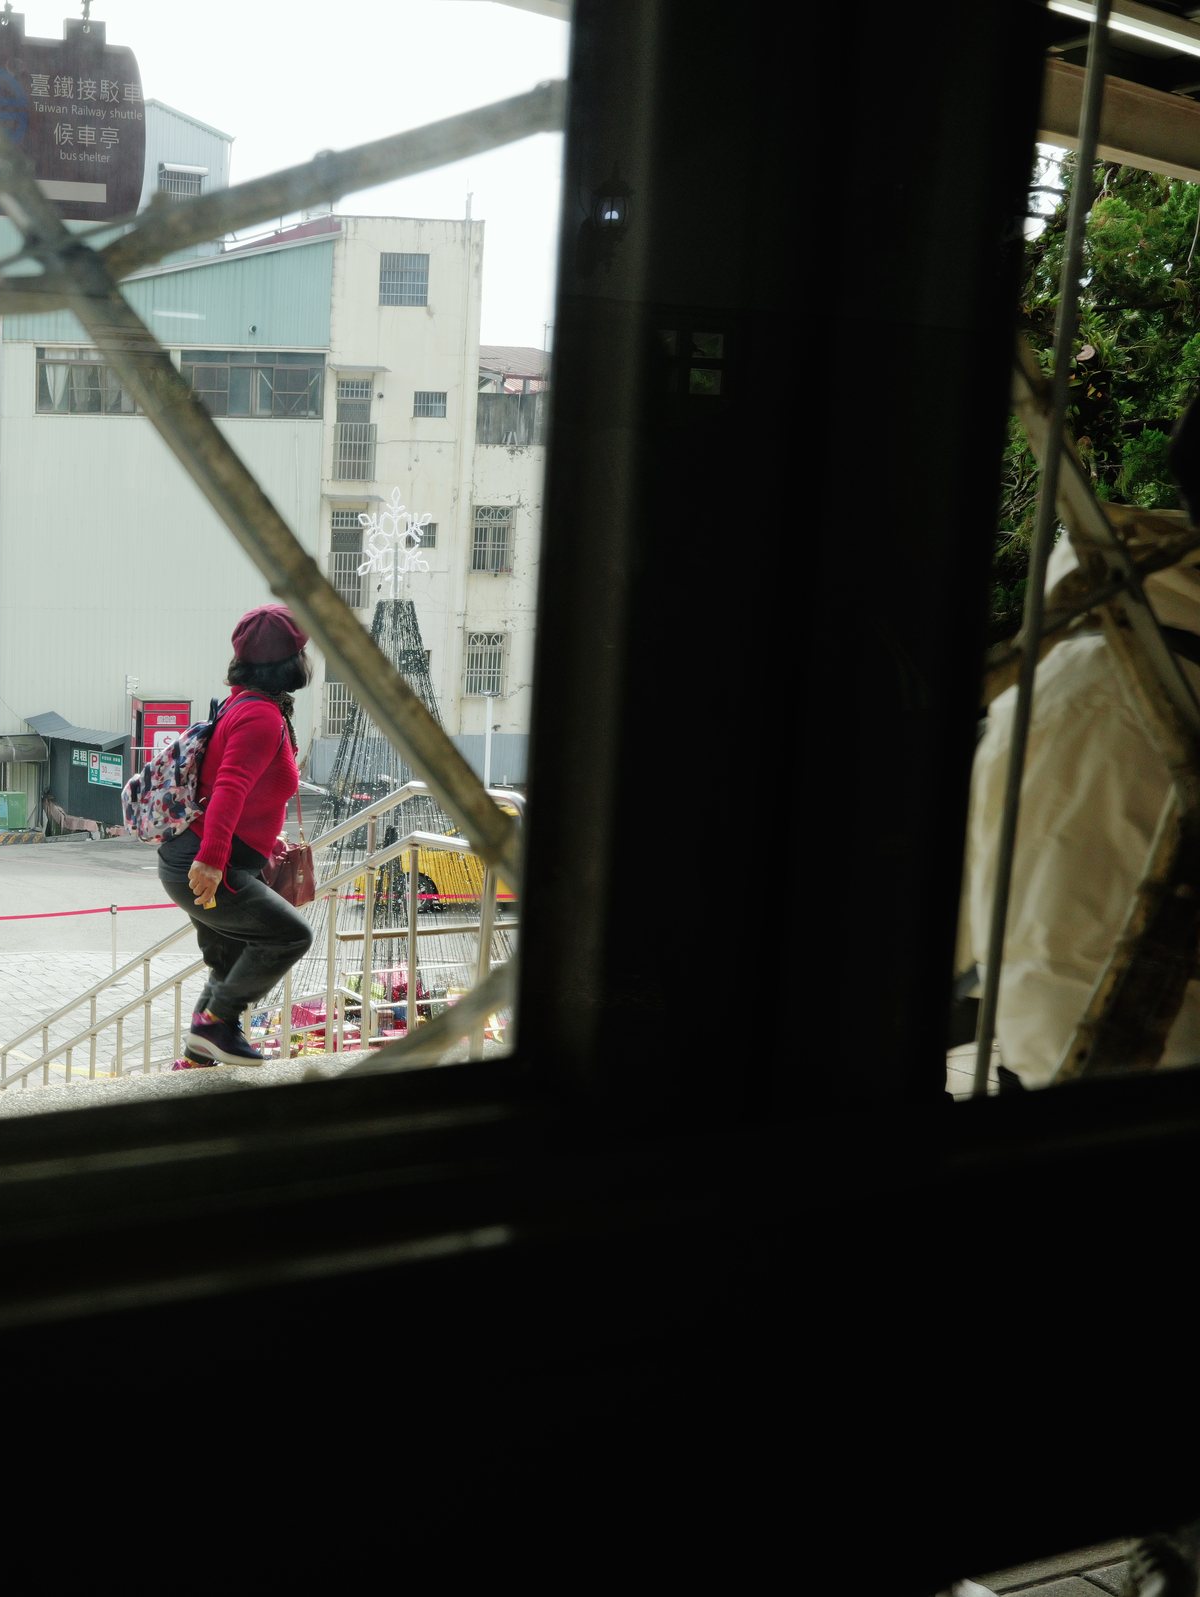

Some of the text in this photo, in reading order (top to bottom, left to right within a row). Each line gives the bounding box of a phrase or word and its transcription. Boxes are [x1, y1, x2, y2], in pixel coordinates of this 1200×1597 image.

[30, 74, 143, 104] 臺鐵接駁車
[34, 102, 143, 121] Taiwan Railway shuttle
[53, 122, 120, 149] 候車亭
[59, 150, 112, 164] bus shelter
[72, 749, 88, 761] 月租
[91, 754, 98, 768] P
